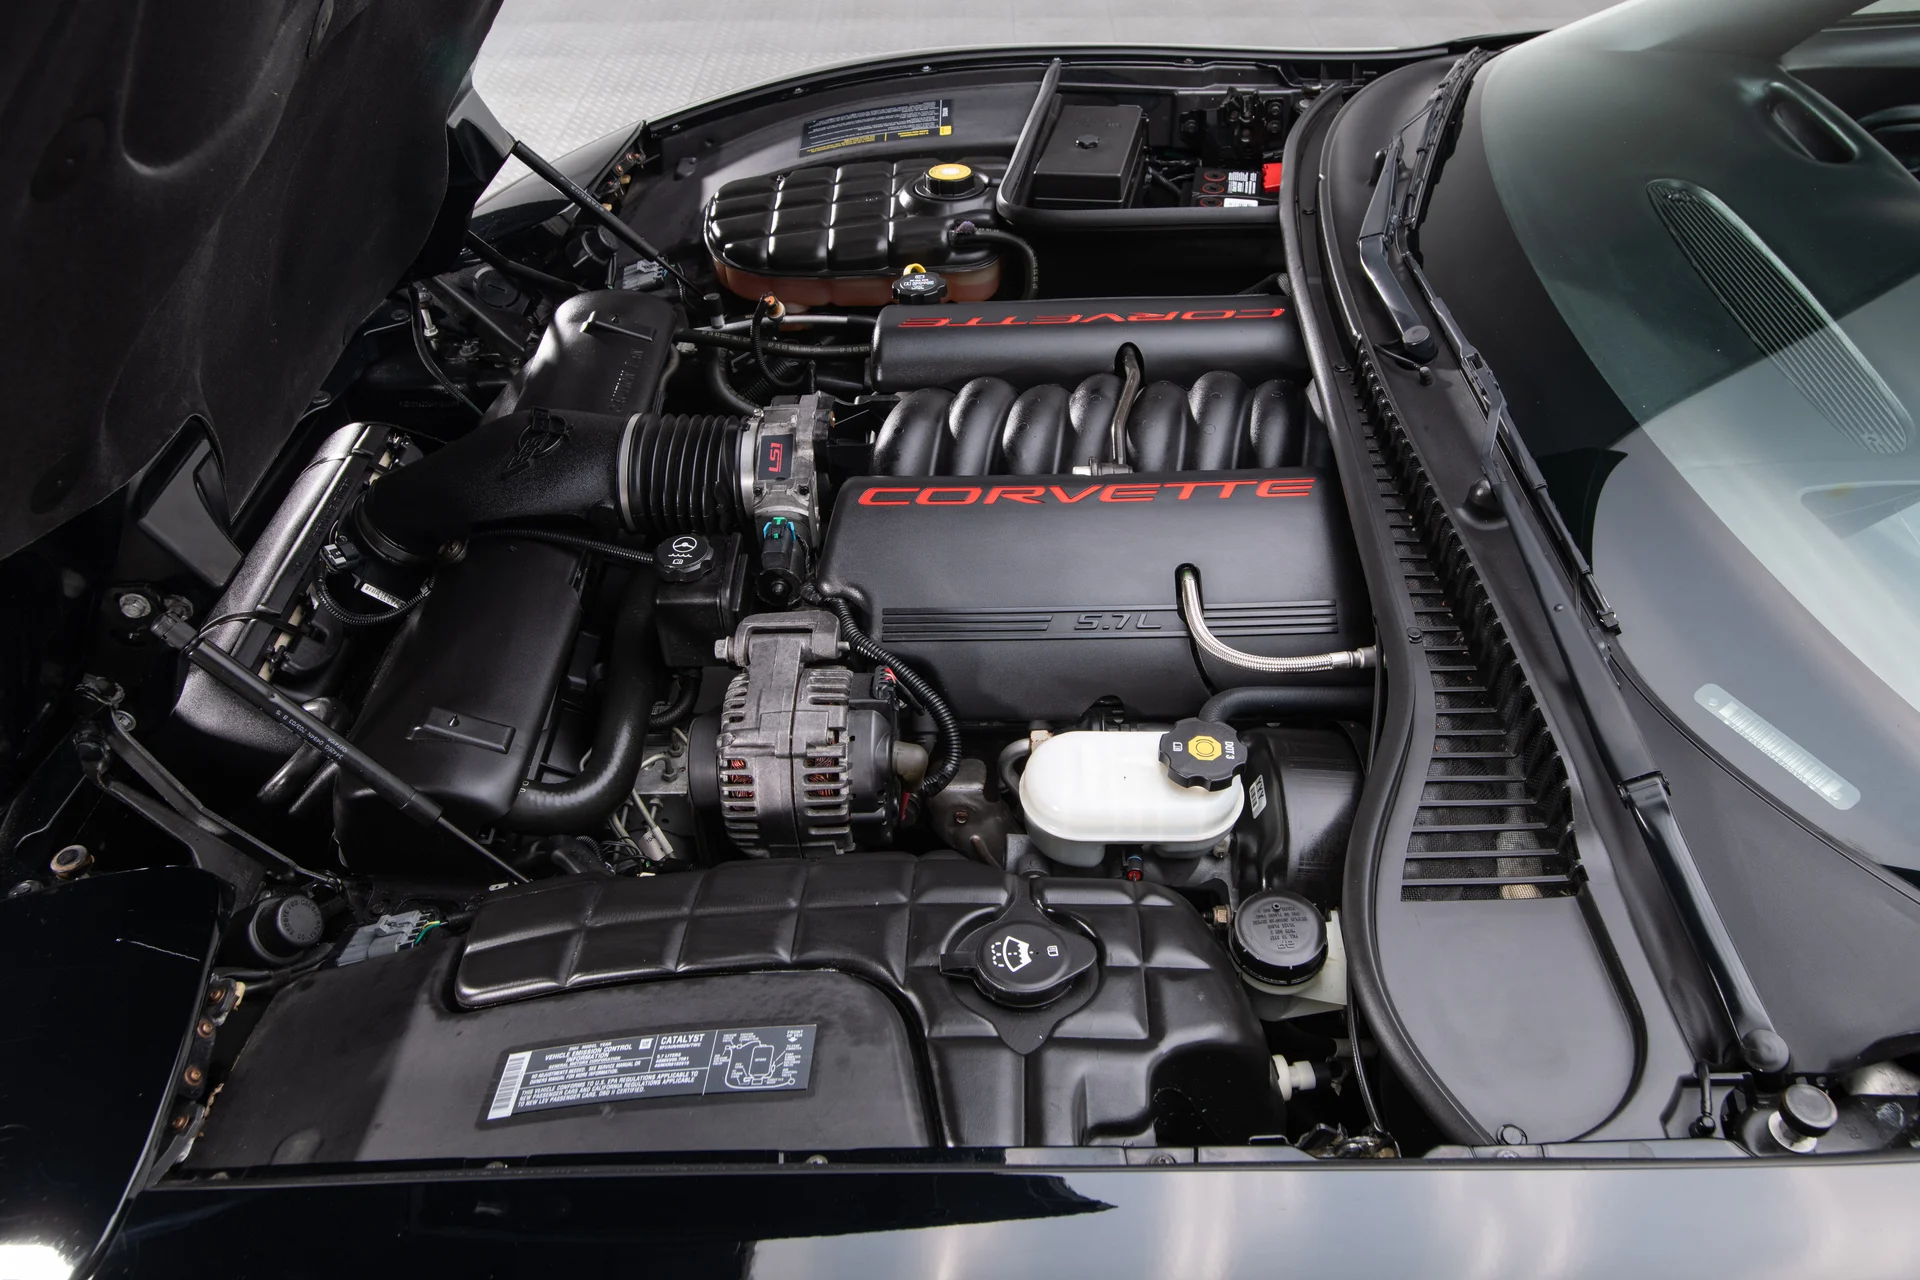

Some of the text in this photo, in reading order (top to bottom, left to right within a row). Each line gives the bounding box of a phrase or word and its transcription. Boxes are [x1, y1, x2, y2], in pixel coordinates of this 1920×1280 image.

[900, 308, 1284, 327] CORVETTE
[858, 478, 1315, 506] CORVETTE
[1074, 613, 1162, 631] 5.7L
[1225, 741, 1235, 753] DOT
[660, 1033, 705, 1045] CATALYST
[545, 1043, 633, 1061] VEHICLE EMISSION CONTROL
[565, 1051, 610, 1062] INFORMATION
[538, 1068, 568, 1078] ADJUSTMENTS
[532, 1091, 564, 1099] PASSENGER
[591, 1083, 623, 1091] CALIFORNIA
[623, 1079, 661, 1087] REGULATIONS
[662, 1076, 696, 1085] APPLICABLE
[534, 1085, 556, 1094] VEHICLE
[556, 1082, 586, 1091] CONFORMS
[619, 1073, 656, 1083] REGULATIONS
[657, 1071, 689, 1080] APPLICABLE
[549, 1094, 581, 1103] PASSENGER
[616, 1087, 646, 1095] CERTIFIED.
